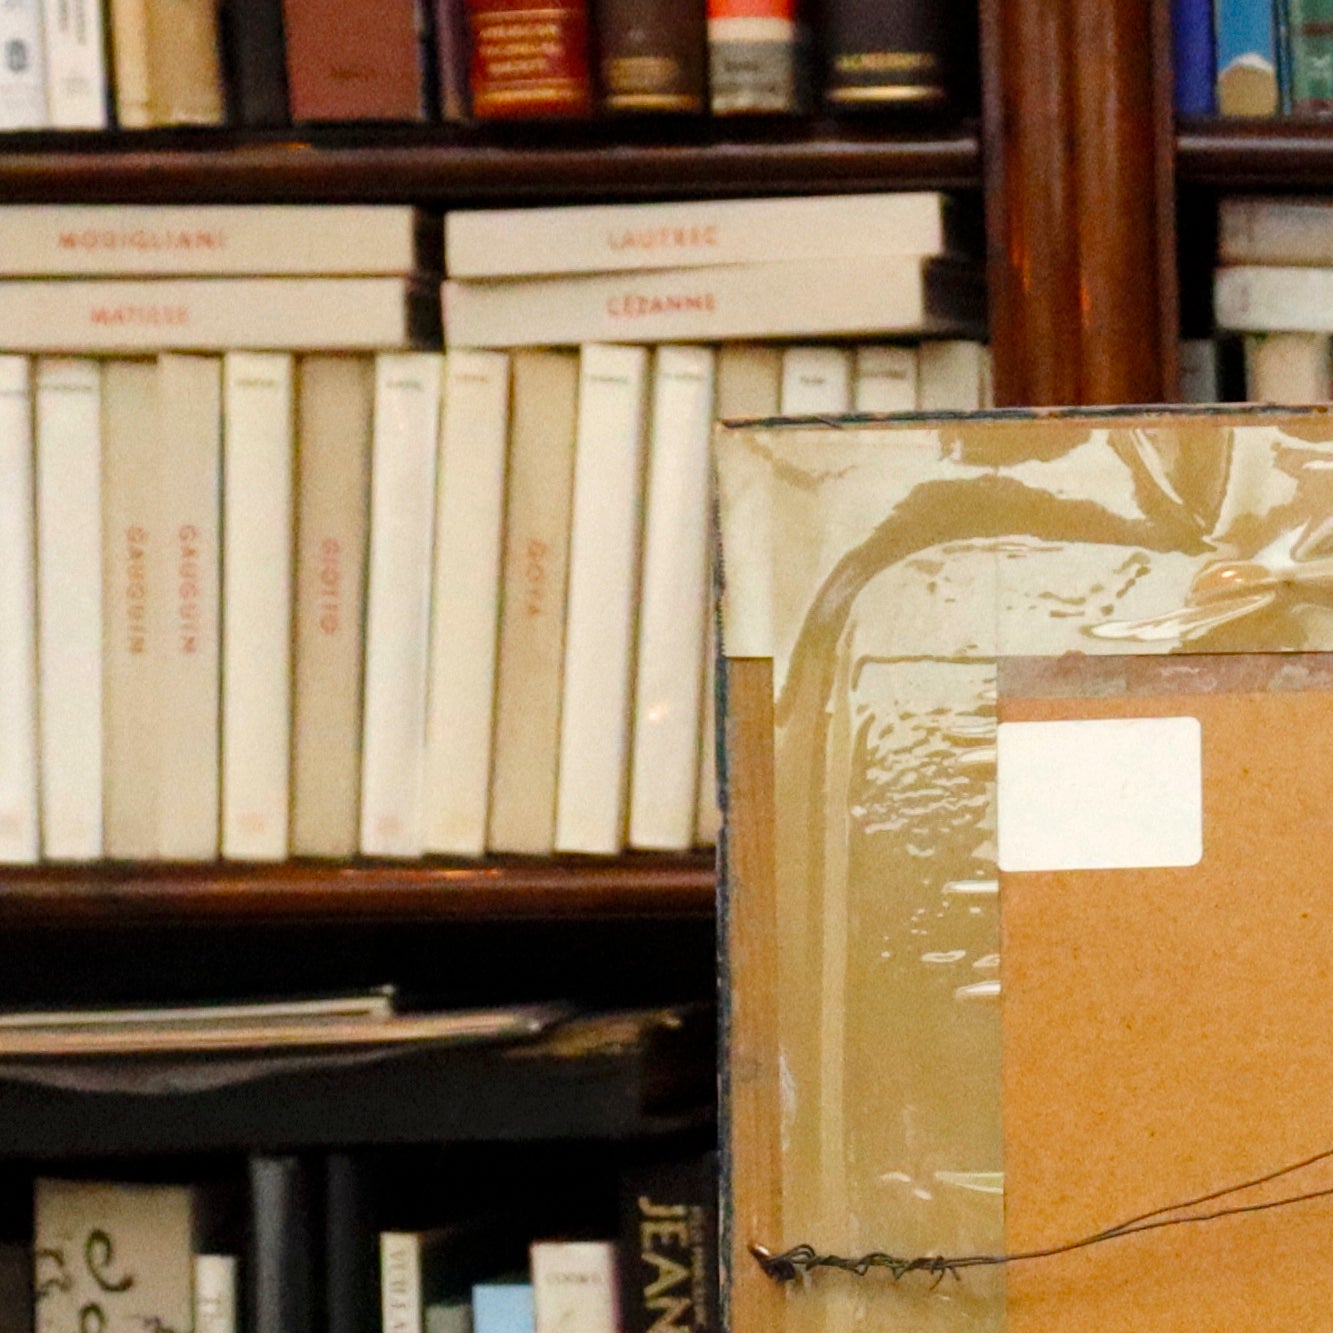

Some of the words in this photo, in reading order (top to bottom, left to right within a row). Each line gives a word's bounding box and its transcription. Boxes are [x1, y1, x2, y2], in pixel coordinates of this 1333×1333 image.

[58, 228, 229, 251] MODIGLIANI
[607, 224, 718, 250] LAUTREC
[90, 304, 190, 326] MATISSE
[125, 525, 147, 656] GAUGUIN
[178, 524, 198, 655] GAUGUIN
[318, 537, 341, 636] GIOTTO
